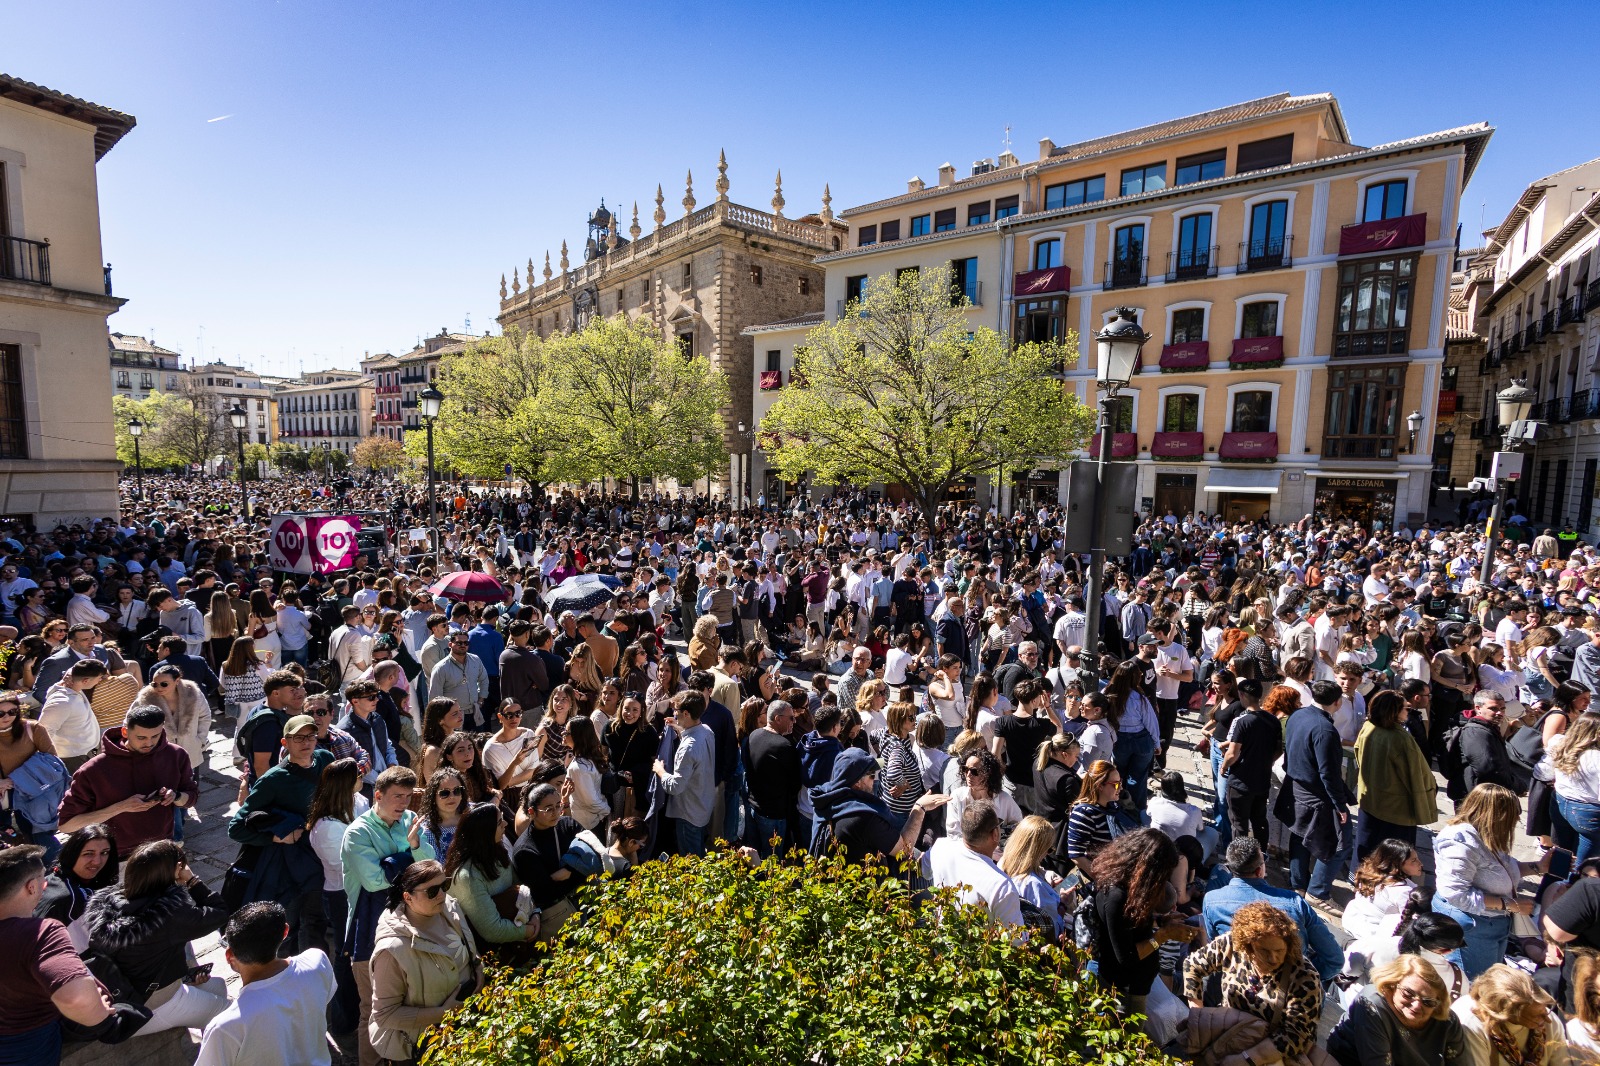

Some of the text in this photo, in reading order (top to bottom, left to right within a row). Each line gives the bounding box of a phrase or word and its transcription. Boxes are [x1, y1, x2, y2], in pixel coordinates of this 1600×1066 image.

[1327, 478, 1351, 486] SABOR
[278, 531, 301, 550] 101
[275, 557, 287, 568] tv
[314, 561, 329, 572] tv
